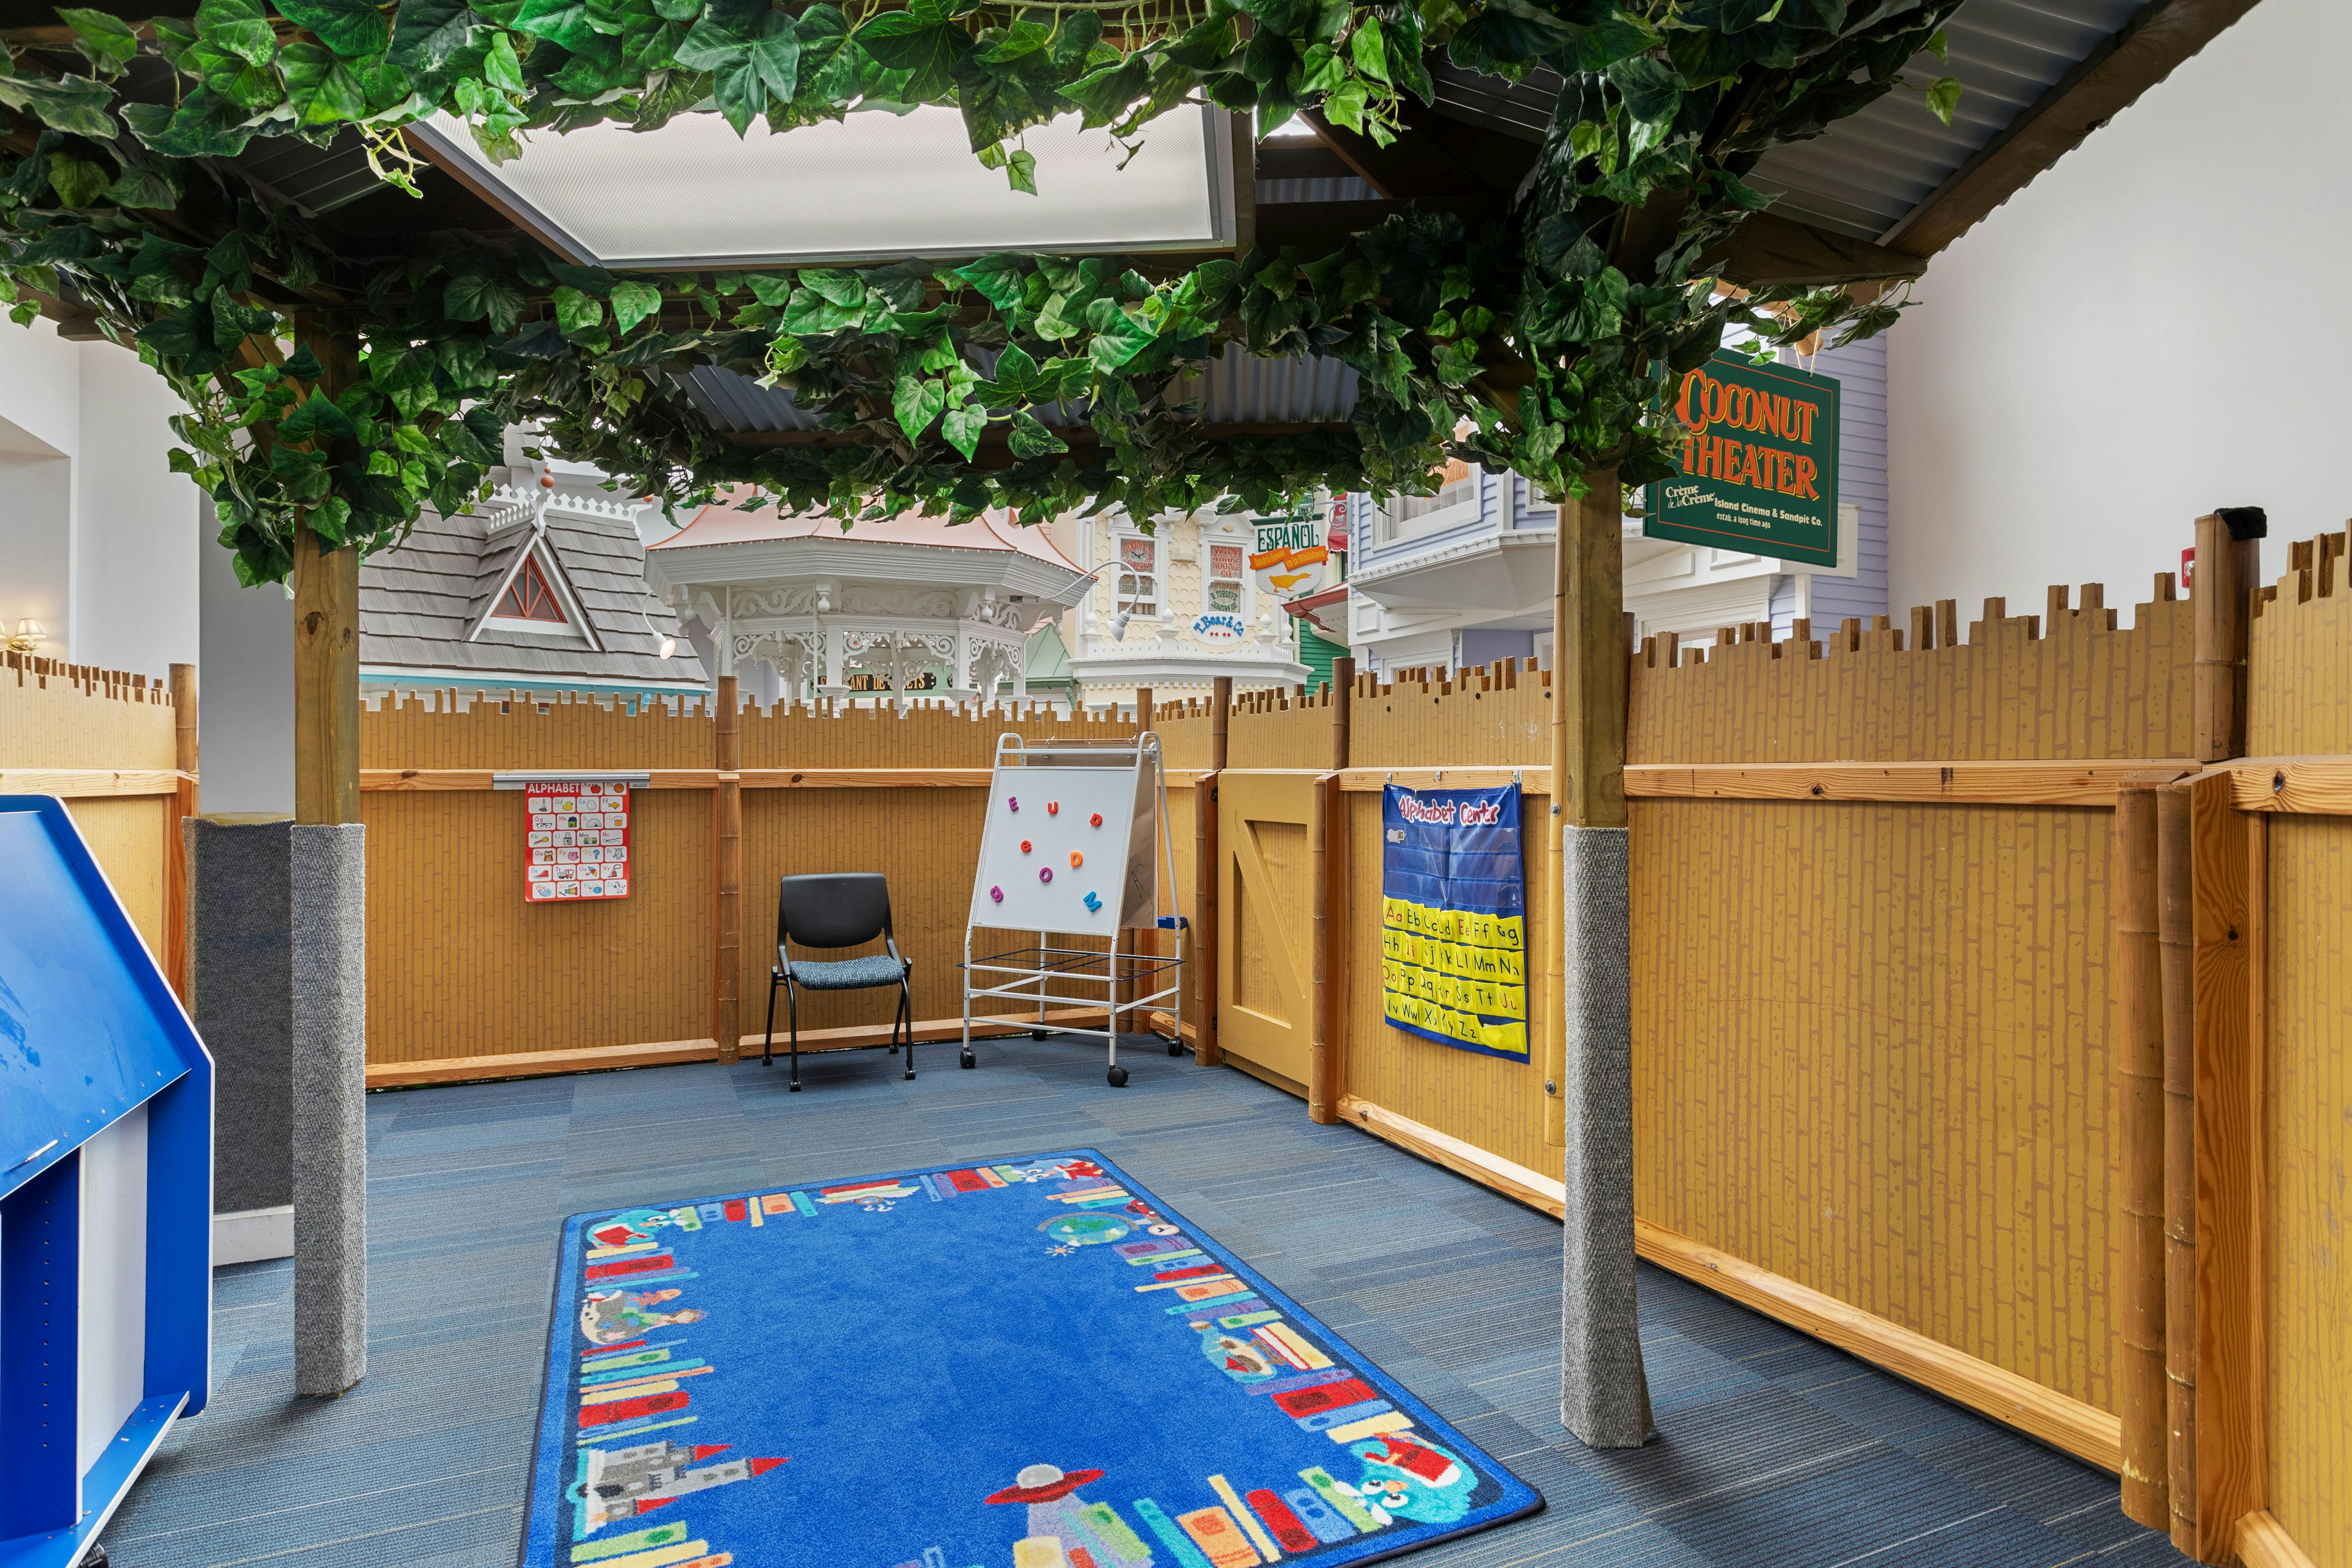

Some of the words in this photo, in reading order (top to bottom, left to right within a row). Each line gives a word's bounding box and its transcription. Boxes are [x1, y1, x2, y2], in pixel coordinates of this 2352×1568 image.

[1675, 368, 1818, 444] COCONUT
[1682, 434, 1819, 501] THEATER
[1665, 485, 1699, 498] Crème
[1714, 498, 1739, 510] Island
[1741, 503, 1770, 517] Cinema
[1772, 508, 1778, 518] &
[1780, 510, 1809, 524] Sandpit
[1811, 516, 1822, 526] Co.
[1717, 513, 1732, 522] estab.
[1738, 516, 1748, 526] long
[1749, 518, 1761, 527] time
[1258, 524, 1319, 552] ESPAÑOL
[1212, 546, 1241, 555] WIDE
[1297, 550, 1325, 563] Biblioteca
[1212, 562, 1241, 570] NOODLE
[1213, 555, 1241, 563] AWAKE
[1215, 590, 1238, 601] TORGOVE
[1201, 616, 1226, 629] Bear
[1226, 616, 1233, 628] &
[528, 783, 581, 793] ALPHABET
[1008, 797, 1019, 812] E
[1047, 801, 1058, 814] U
[1399, 796, 1455, 823] Alphabet
[1460, 801, 1499, 825] Center
[1021, 840, 1032, 853] e
[1070, 852, 1083, 867] D
[1039, 867, 1052, 883] O
[990, 885, 1004, 903] g
[1083, 891, 1102, 913] M
[1386, 906, 1402, 922] Aa
[1424, 915, 1438, 931] Cc
[1458, 919, 1470, 936] Ee
[1474, 922, 1489, 939] Ff
[1497, 924, 1519, 946] Gg
[1383, 935, 1399, 952] Hh
[1407, 940, 1415, 957] Ii
[1456, 952, 1468, 969] Ll
[1474, 954, 1496, 973] Mm
[1499, 956, 1520, 976] Nn
[1383, 965, 1396, 982] Oo
[1400, 968, 1414, 991] Pp
[1420, 973, 1434, 997] Qq
[1456, 986, 1469, 1003] Ss
[1476, 989, 1492, 1006] Tt
[1499, 991, 1517, 1010] Uu
[1385, 997, 1398, 1014] Vv
[1402, 1002, 1417, 1021] Ww
[1424, 1008, 1438, 1026] Xx
[1458, 1020, 1477, 1038] Zz
